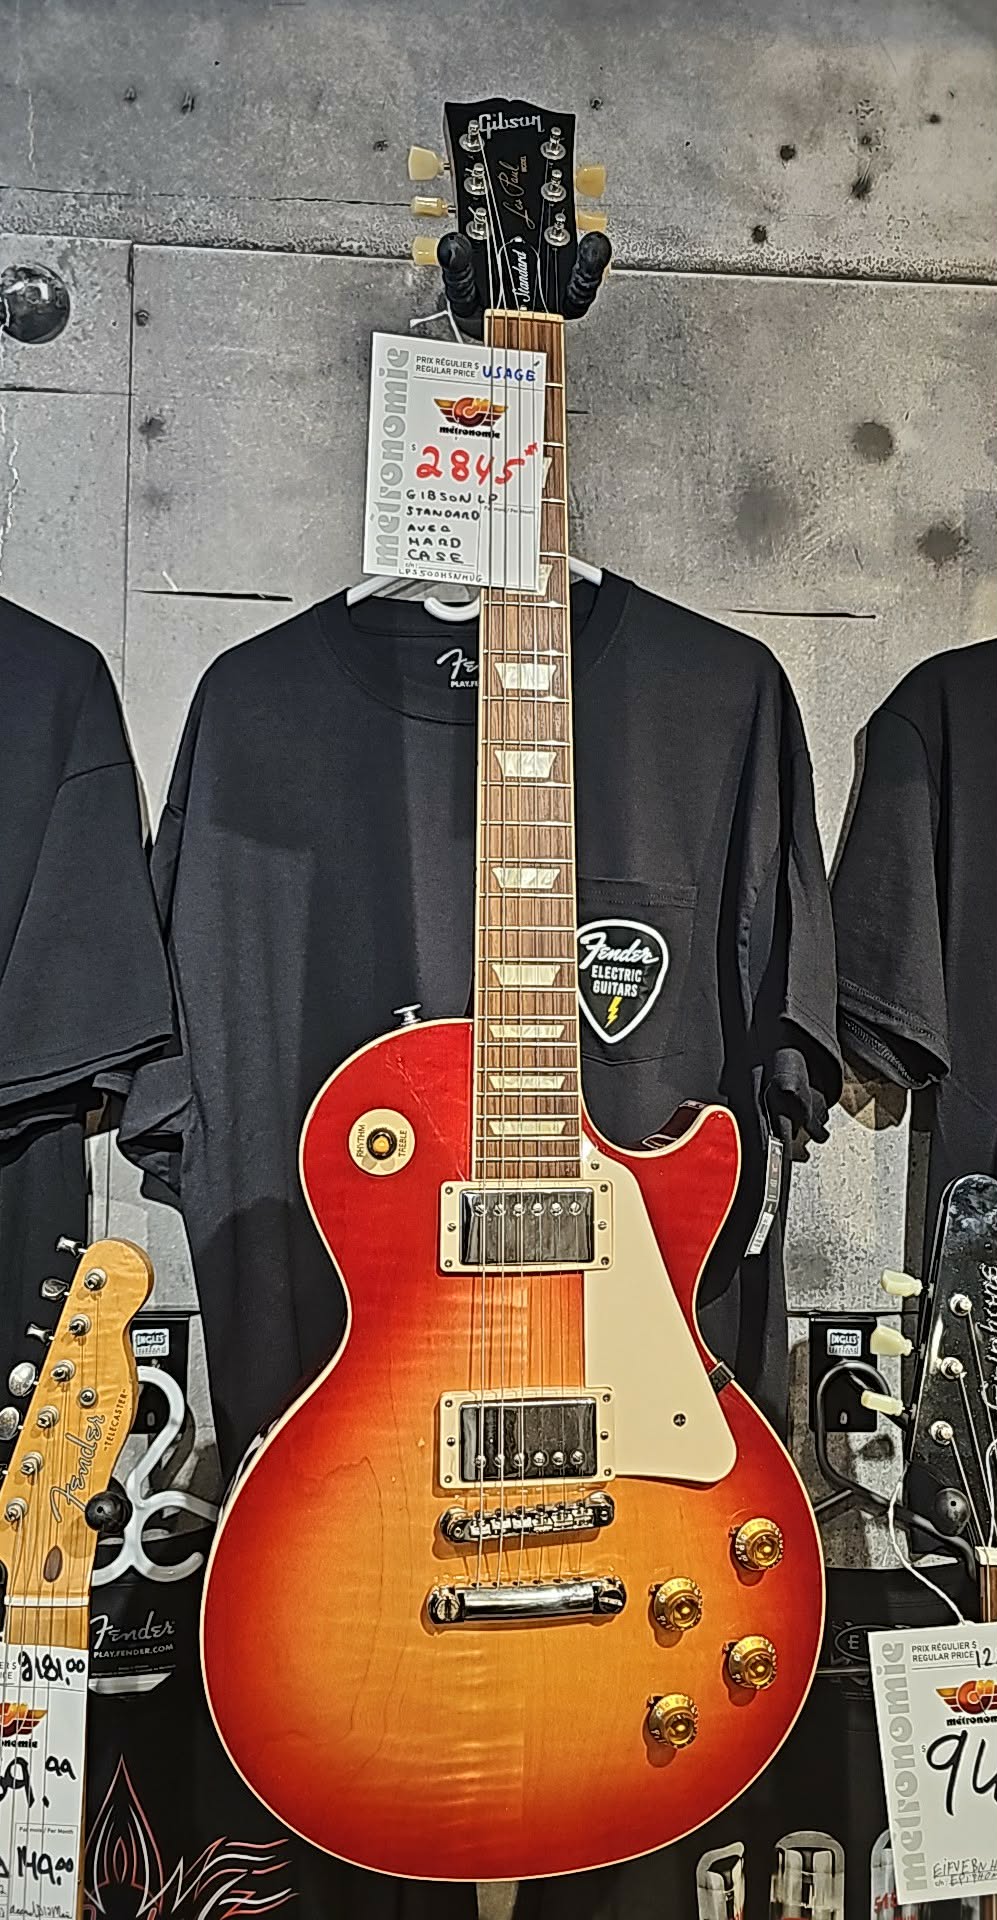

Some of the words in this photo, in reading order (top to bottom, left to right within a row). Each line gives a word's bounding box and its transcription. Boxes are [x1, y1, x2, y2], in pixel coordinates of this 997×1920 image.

[478, 111, 546, 140] Gibson
[497, 160, 524, 197] Paul
[511, 248, 531, 303] Standard
[415, 364, 451, 376] REGULAR
[453, 368, 476, 378] PRICE
[416, 355, 434, 364] PRIX
[435, 356, 473, 370] RÉGULIER
[482, 360, 541, 382] USAGÉ
[439, 425, 501, 439] métronomie
[370, 347, 410, 567] métronomie
[406, 489, 472, 503] GIBSON
[477, 493, 498, 504] LP
[406, 506, 481, 521] STANDARD
[408, 536, 462, 548] HARD
[407, 549, 464, 564] CASE
[579, 931, 660, 970] Fender
[591, 964, 643, 983] ELECTRIC
[592, 980, 638, 998] GUITARS
[356, 1124, 366, 1158] RHYTHM
[398, 1129, 408, 1158] TREBLE
[50, 1414, 105, 1523] Fender
[90, 1610, 175, 1650] Fender
[93, 1643, 174, 1659] PLAY.FENDER.COM
[911, 1644, 930, 1653] PRIX
[931, 1641, 970, 1652] RÉGULIER
[912, 1652, 950, 1663] REGULAR
[951, 1650, 975, 1660] PRICE
[976, 1647, 997, 1668] 12
[876, 1642, 928, 1891] métronomie
